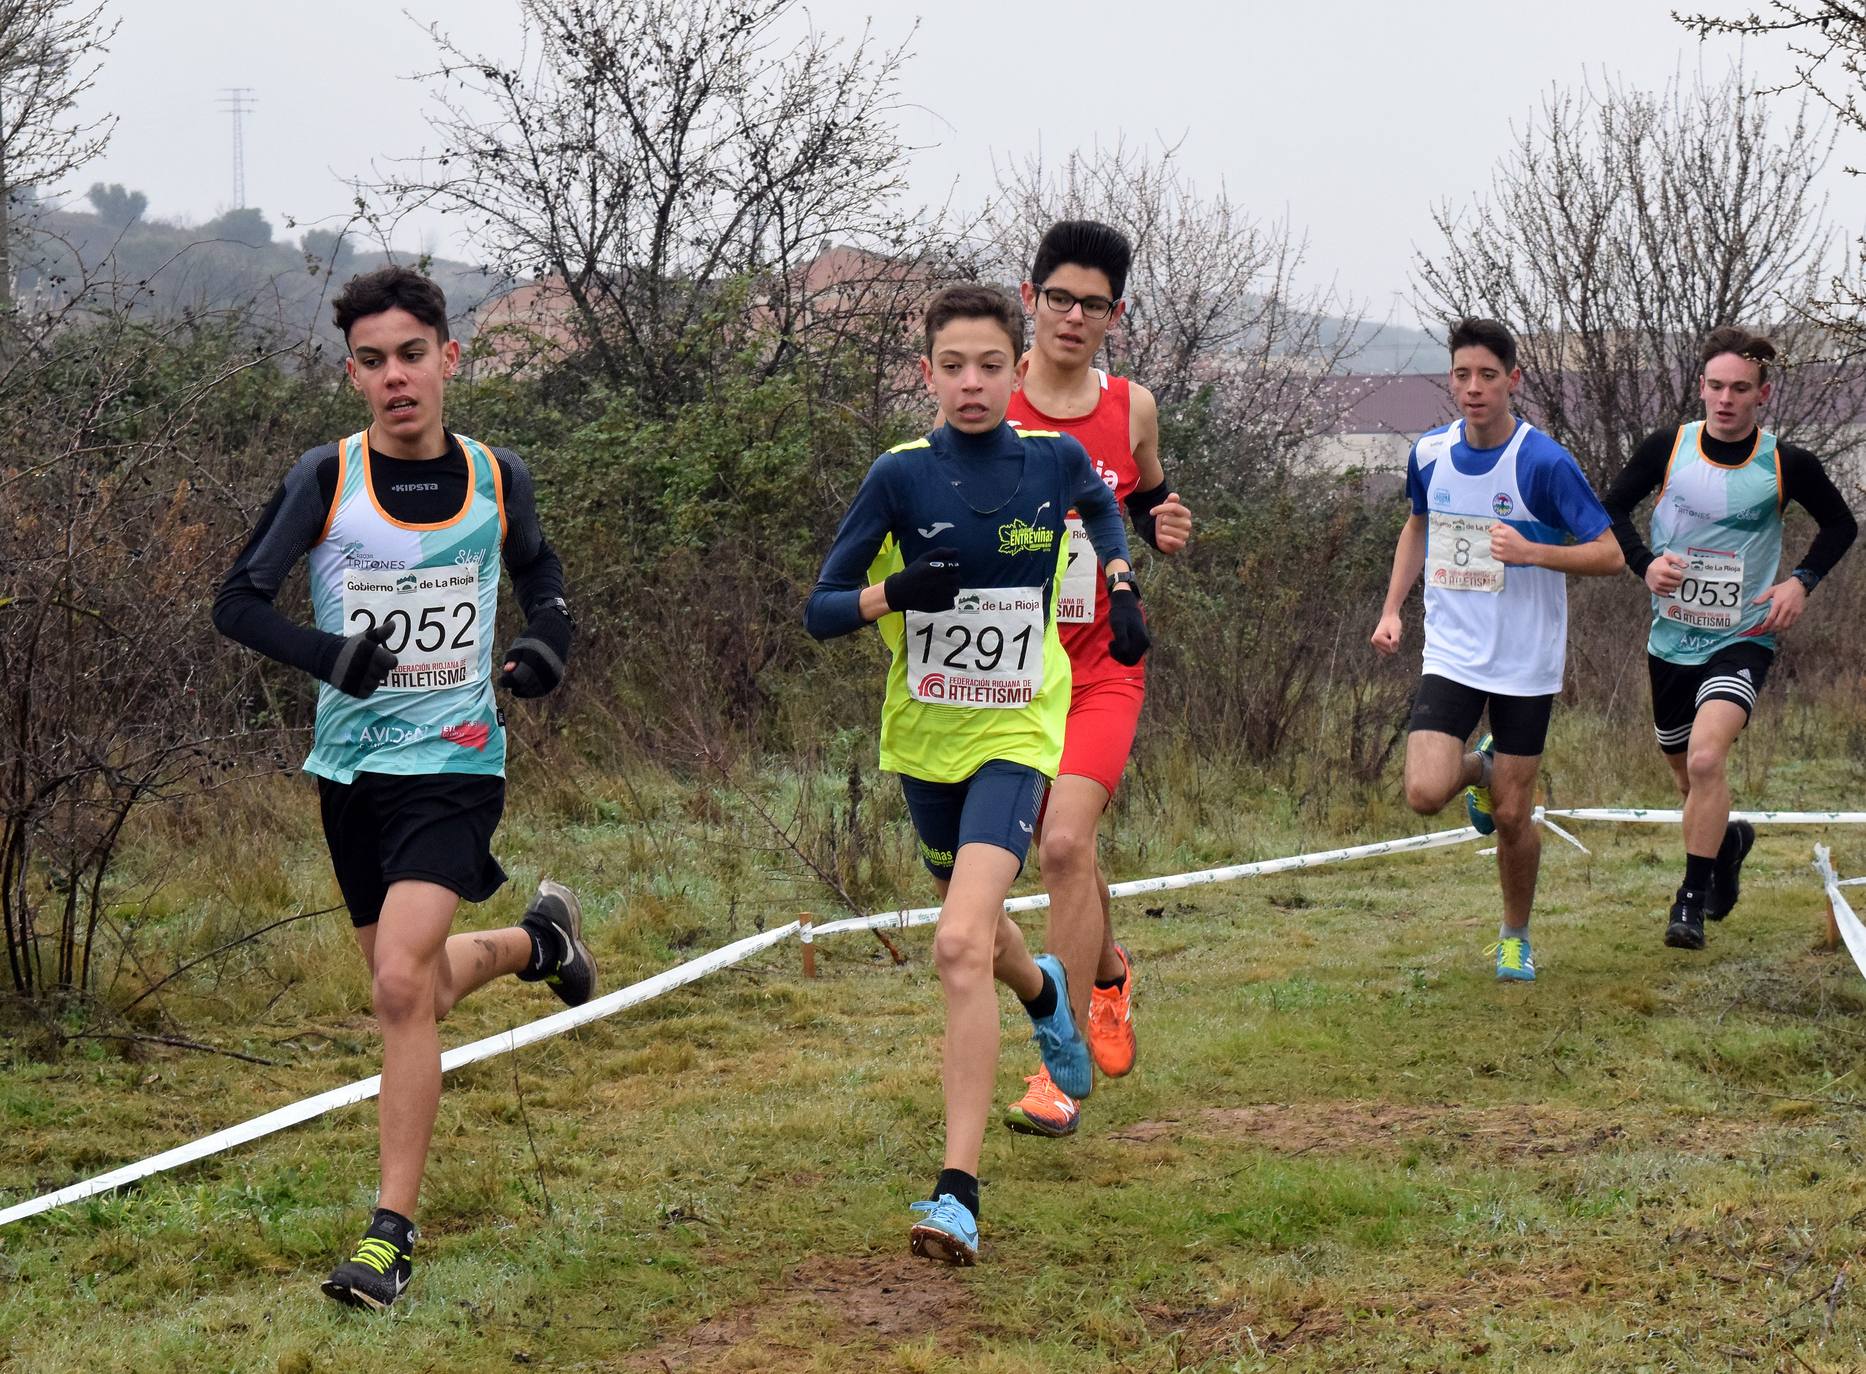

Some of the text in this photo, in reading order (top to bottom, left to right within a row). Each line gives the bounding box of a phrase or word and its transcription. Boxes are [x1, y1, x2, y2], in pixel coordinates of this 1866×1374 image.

[1454, 538, 1471, 566] 8
[348, 559, 406, 570] TRITONES
[347, 575, 474, 592] Gobierno de La Rioja
[1669, 578, 1740, 607] 053
[982, 600, 1040, 611] de La Rioja
[1683, 613, 1731, 628] ATLETISMO
[916, 622, 1032, 671] 1291
[432, 660, 459, 671] RIOJANA
[391, 666, 467, 688] ATLETISMO
[949, 676, 1032, 688] FEDERACIÓN RIOJANA DE
[949, 684, 1032, 704] ATLETISMO
